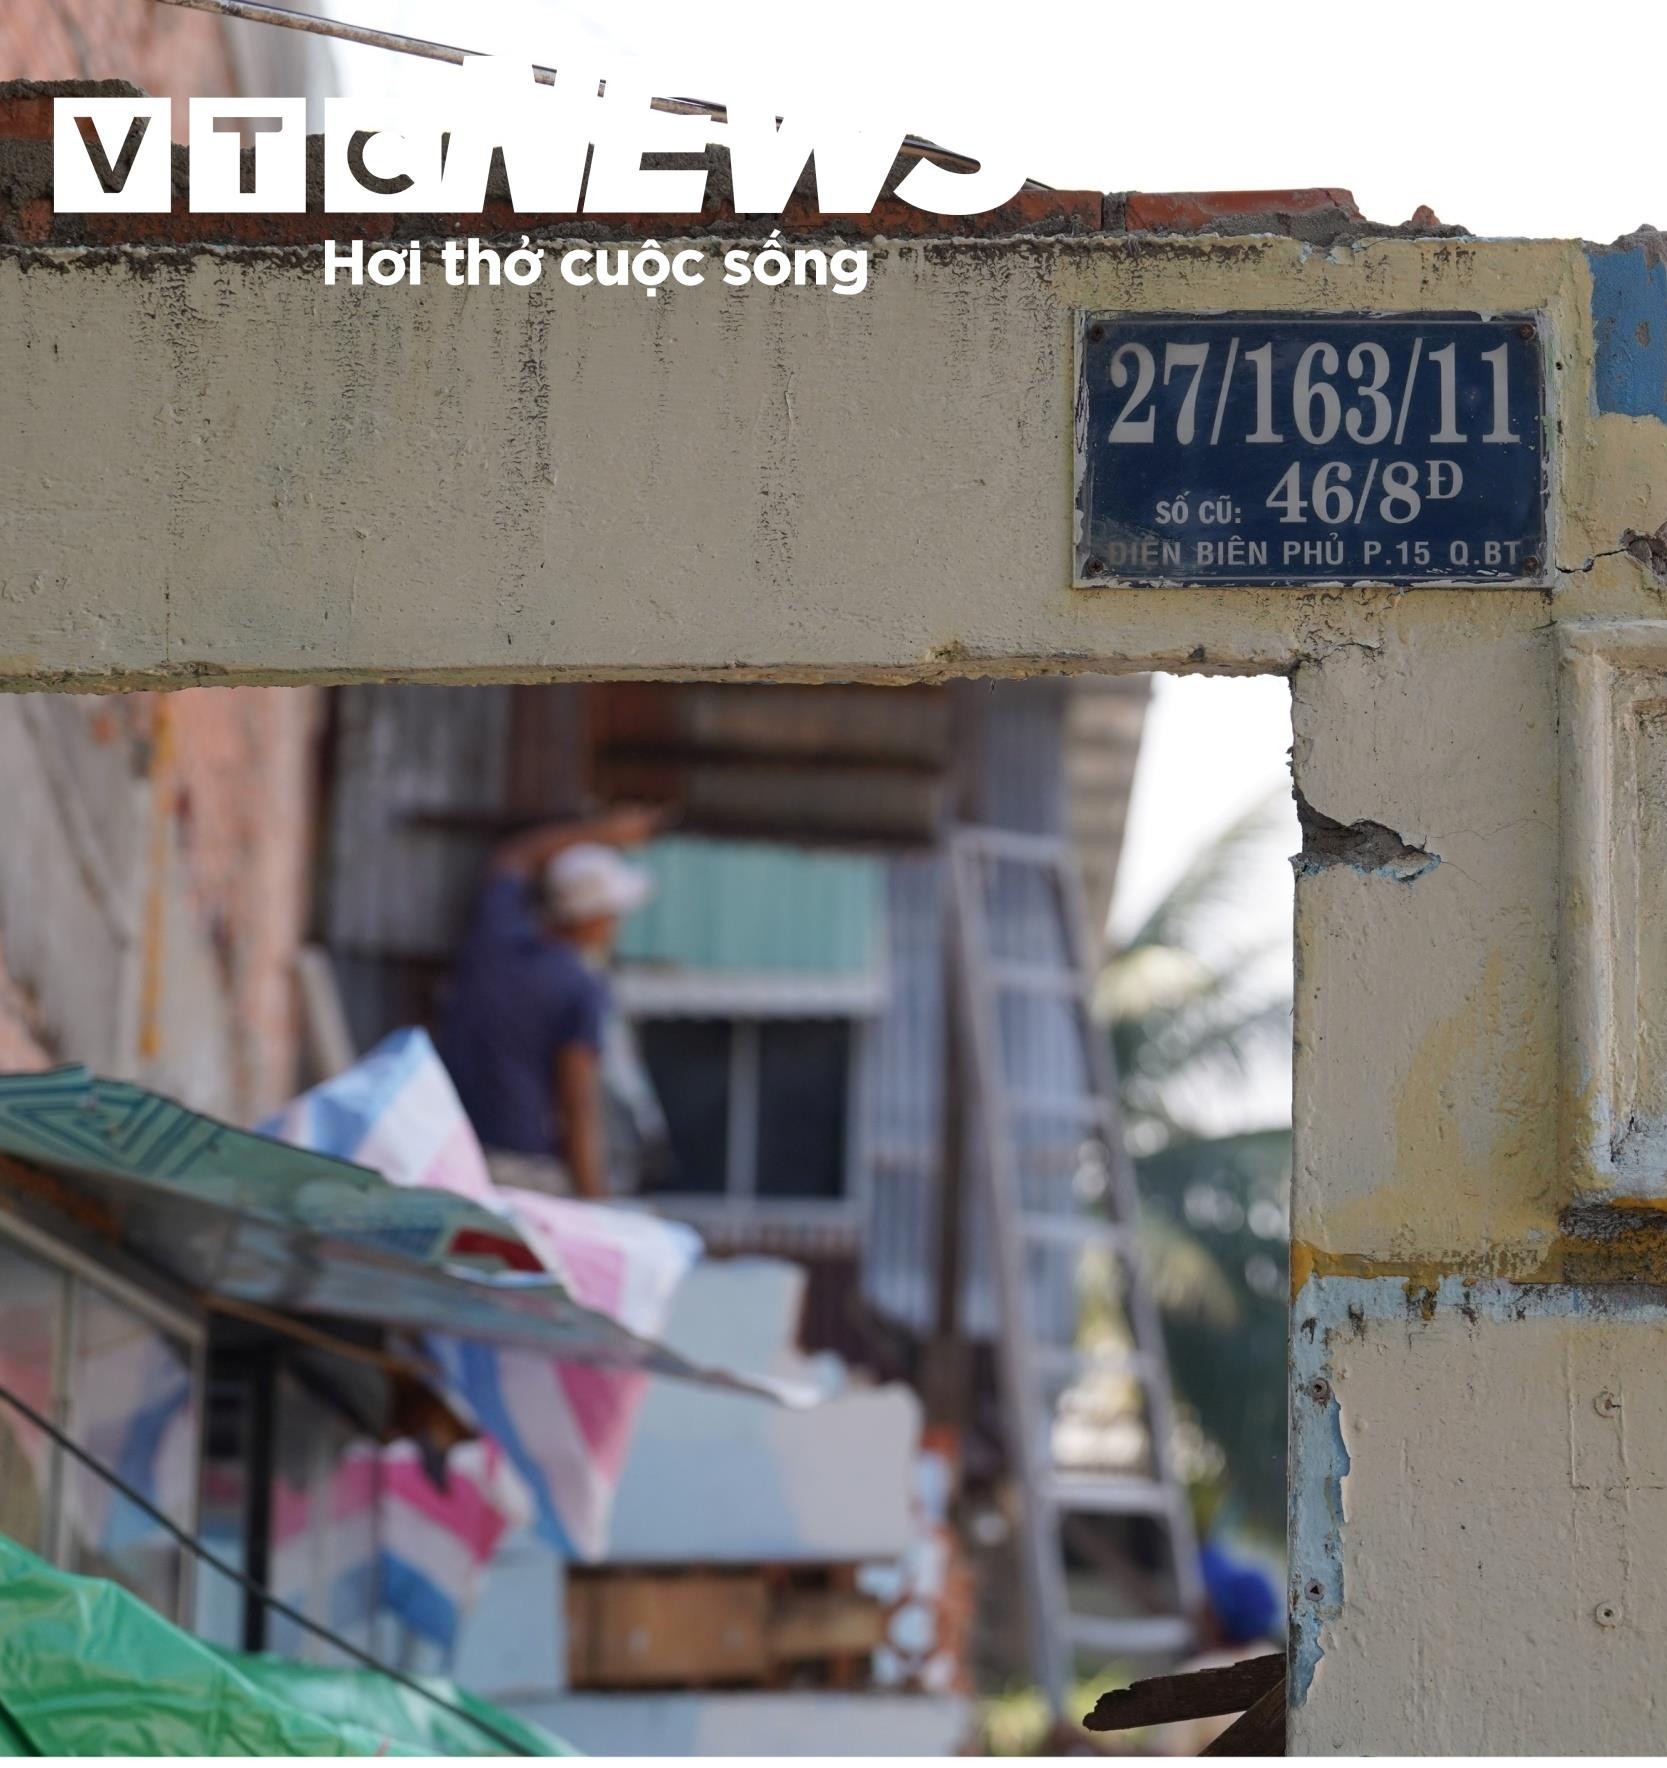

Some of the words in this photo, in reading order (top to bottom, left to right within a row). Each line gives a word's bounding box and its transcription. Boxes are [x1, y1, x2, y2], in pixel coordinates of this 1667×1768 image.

[1107, 336, 1521, 446] 27/163/11
[1155, 490, 1190, 525] SỐ
[1198, 495, 1242, 525] CŨ:
[1196, 535, 1268, 566] BIÊN
[1283, 532, 1345, 566] PHỦ
[1363, 540, 1431, 566] P.15
[1450, 540, 1521, 567] Q.BT
